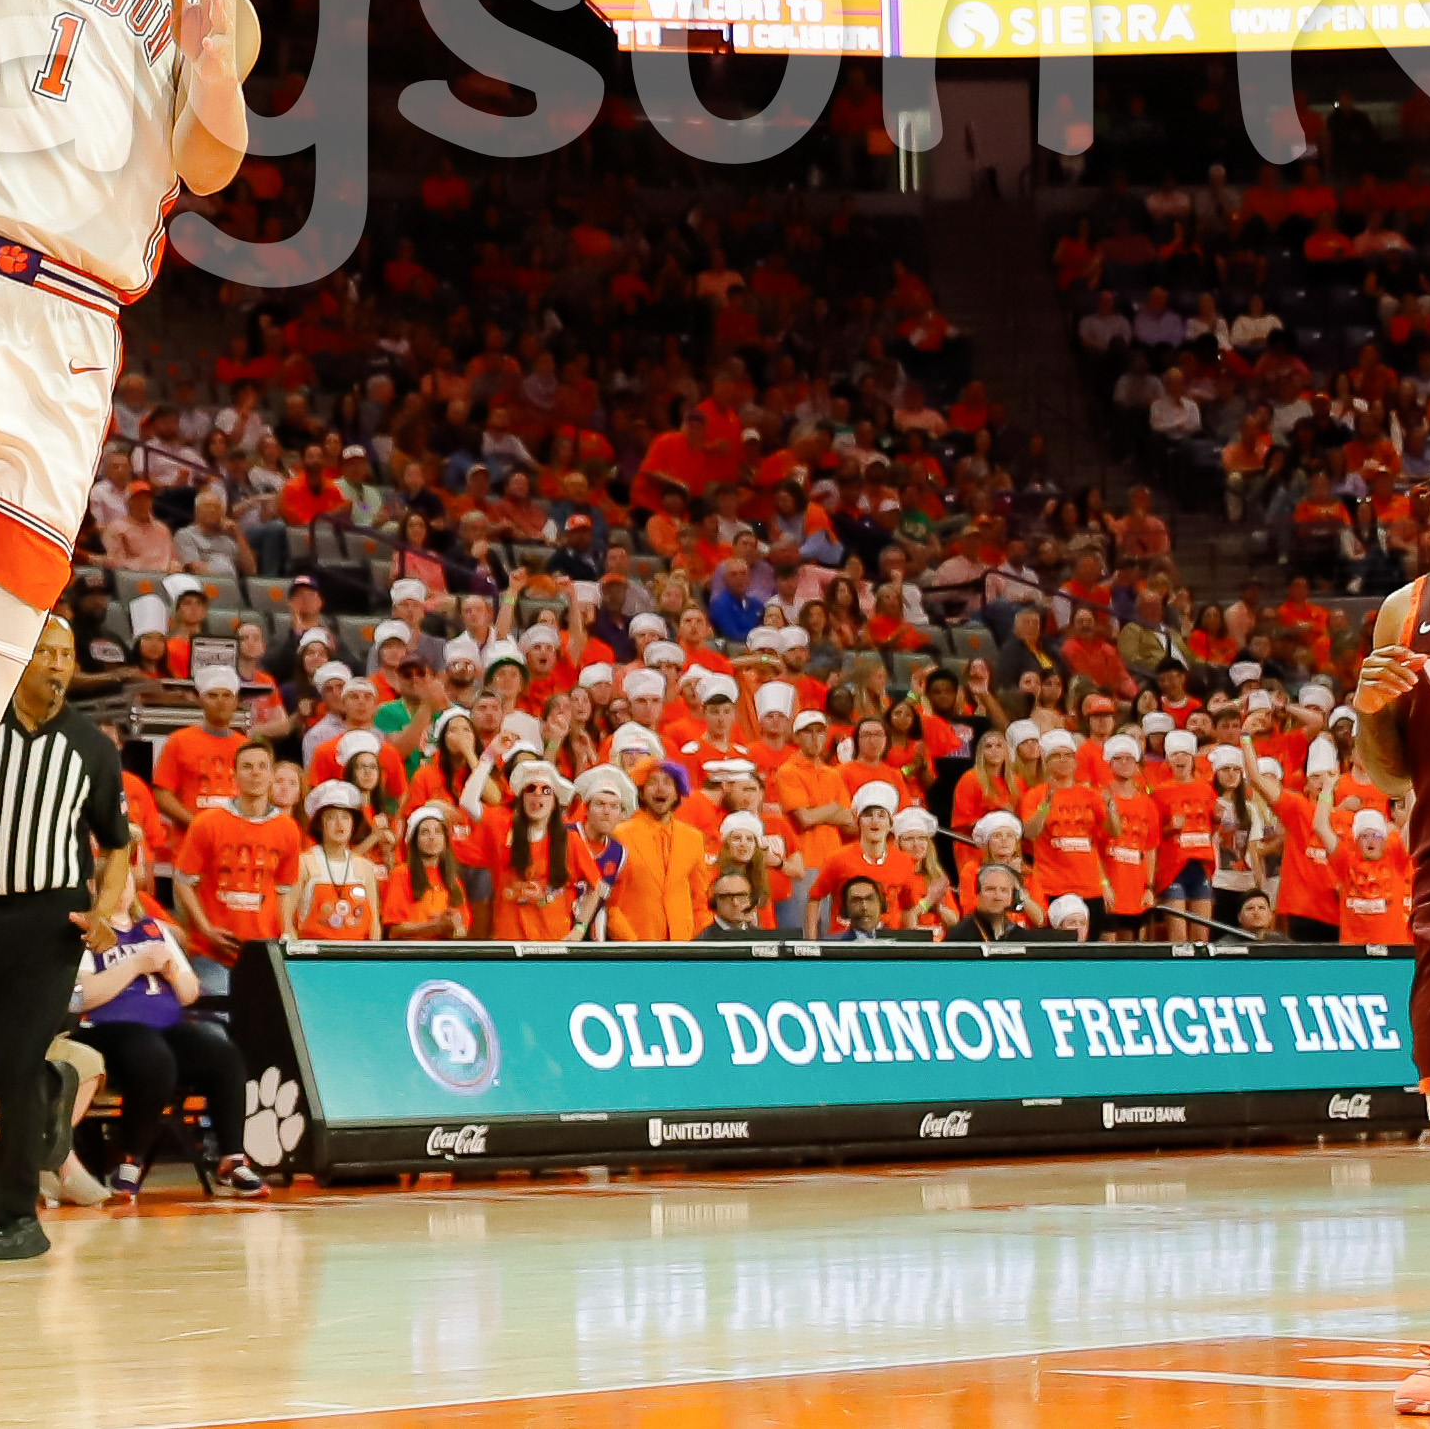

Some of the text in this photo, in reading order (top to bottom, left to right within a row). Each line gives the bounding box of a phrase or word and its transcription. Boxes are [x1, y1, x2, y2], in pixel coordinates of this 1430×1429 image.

[1009, 3, 1197, 46] SIERRA
[1229, 6, 1292, 35] NOW
[1295, 4, 1366, 32] OPEN
[1370, 3, 1399, 31] IN
[33, 11, 87, 103] 1
[568, 994, 1402, 1070] OLD DOMINION FREIGHT LINE
[661, 1121, 749, 1141] UNITED BANK
[1115, 1106, 1186, 1124] UNITED BANK
